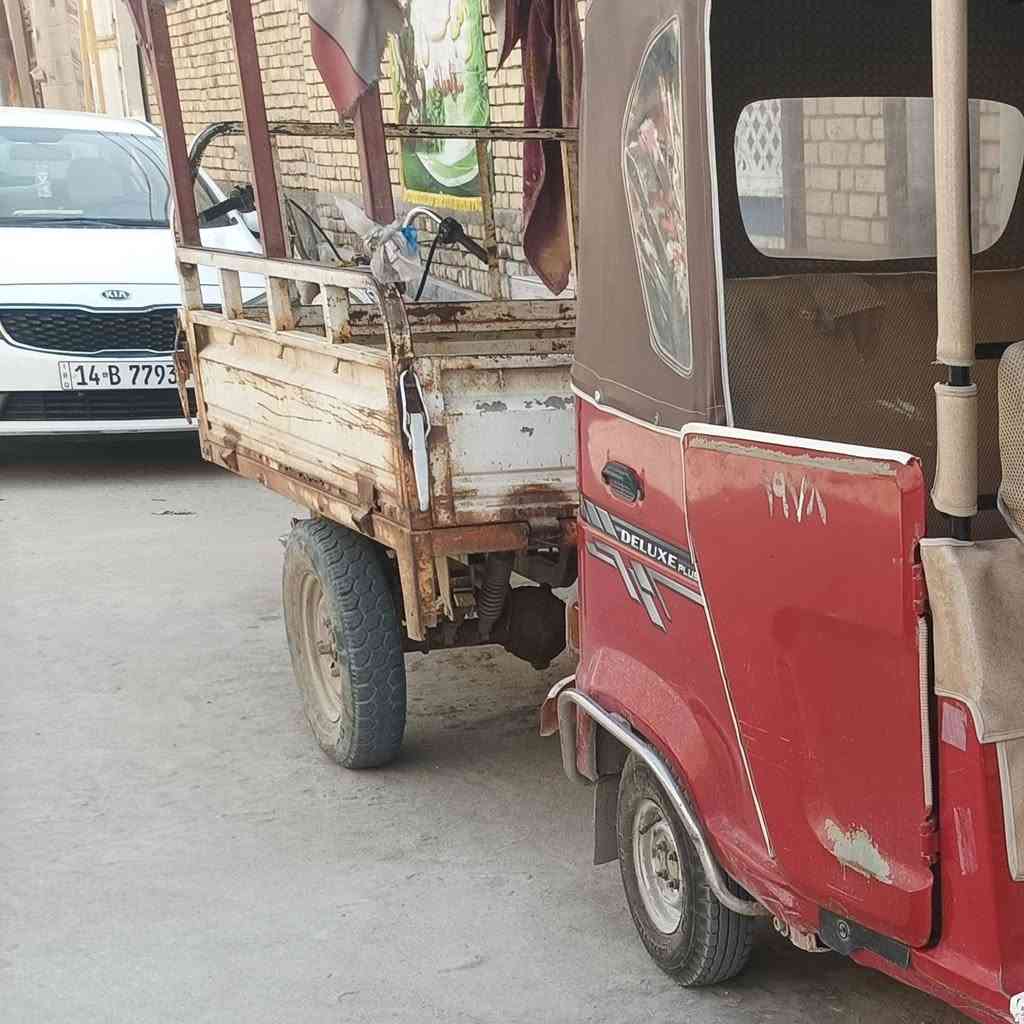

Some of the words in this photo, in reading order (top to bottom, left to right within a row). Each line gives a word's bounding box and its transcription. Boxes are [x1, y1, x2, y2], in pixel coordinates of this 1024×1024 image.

[103, 290, 128, 299] KIA
[129, 365, 177, 385] 7793
[620, 528, 678, 569] DELUXE
